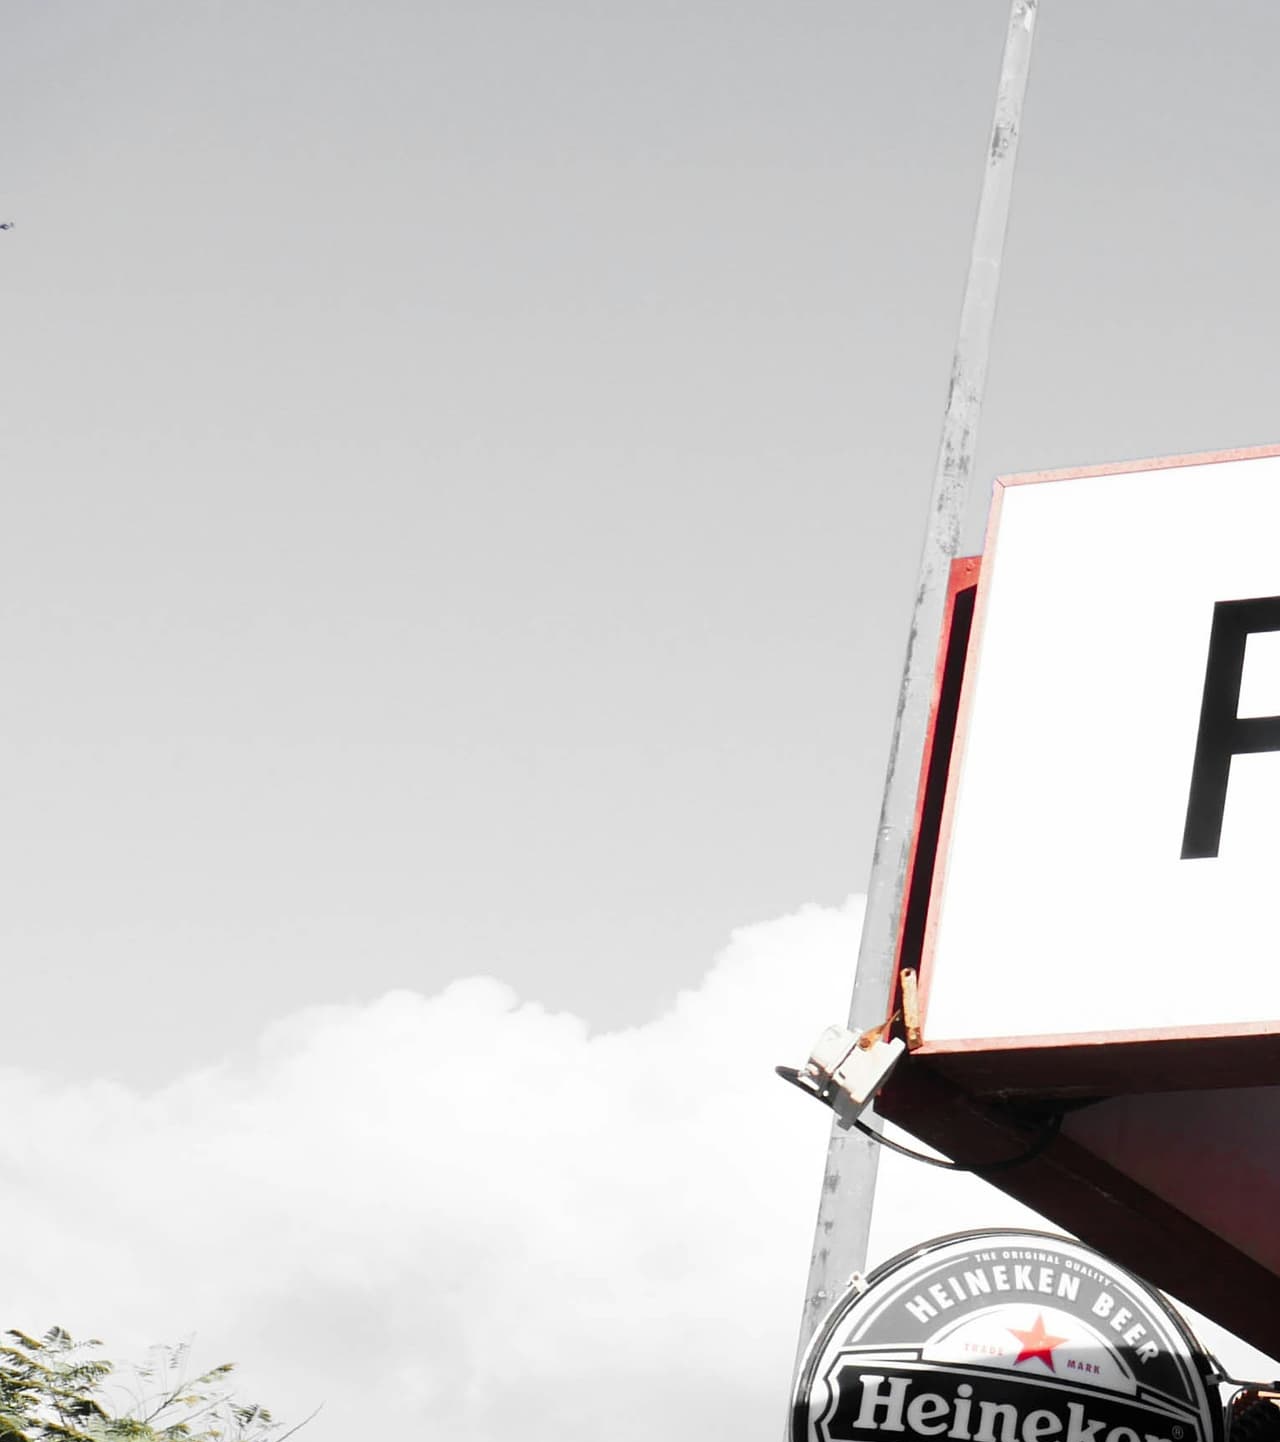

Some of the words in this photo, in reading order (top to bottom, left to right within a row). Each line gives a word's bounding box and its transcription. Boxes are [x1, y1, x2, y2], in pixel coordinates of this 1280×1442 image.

[975, 1251, 997, 1263] THE
[1003, 1251, 1060, 1265] ORIGINAL
[1065, 1259, 1113, 1287] QUALITY
[905, 1264, 1081, 1324] HEINEKEN
[1091, 1292, 1160, 1364] BEER
[1067, 1359, 1102, 1375] MARK
